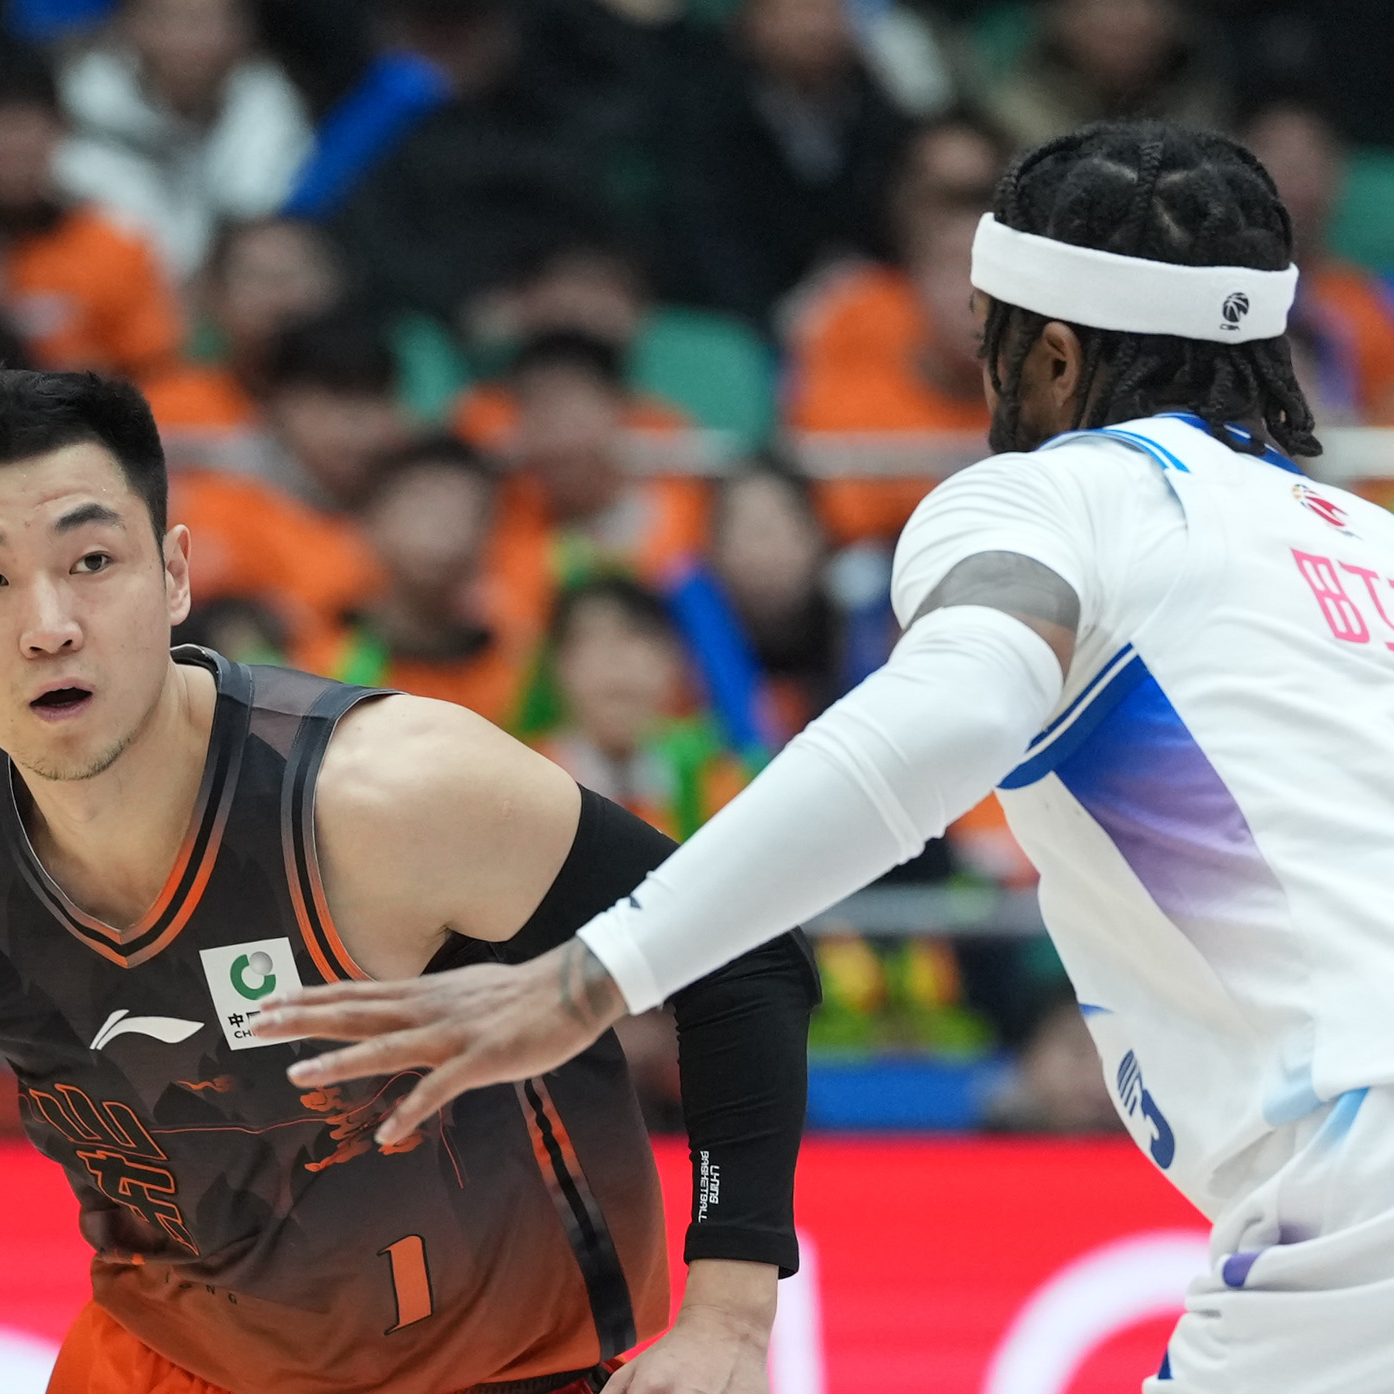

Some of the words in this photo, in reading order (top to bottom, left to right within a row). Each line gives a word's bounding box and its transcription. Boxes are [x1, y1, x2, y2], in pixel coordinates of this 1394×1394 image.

[1116, 1048, 1176, 1171] 3
[697, 1150, 710, 1224] BASKETBALL
[376, 1233, 434, 1336] 1
